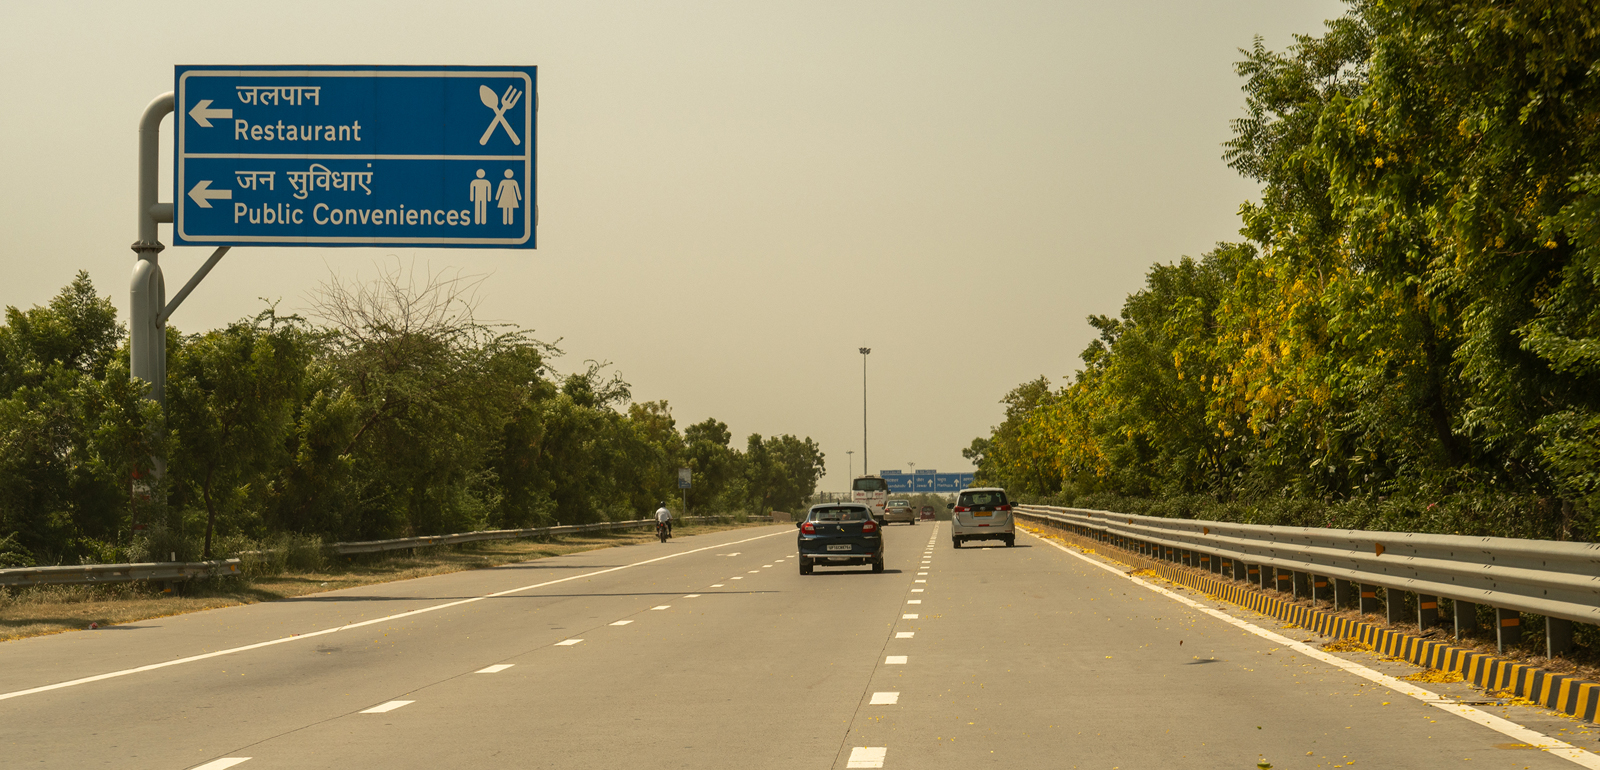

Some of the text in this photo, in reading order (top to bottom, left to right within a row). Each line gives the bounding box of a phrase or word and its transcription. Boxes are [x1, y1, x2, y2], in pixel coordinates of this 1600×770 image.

[236, 86, 321, 106] जलपान
[235, 119, 362, 142] Restaurant
[235, 163, 374, 200] जन सुविधाएं
[234, 203, 471, 226] Public Conveniences
